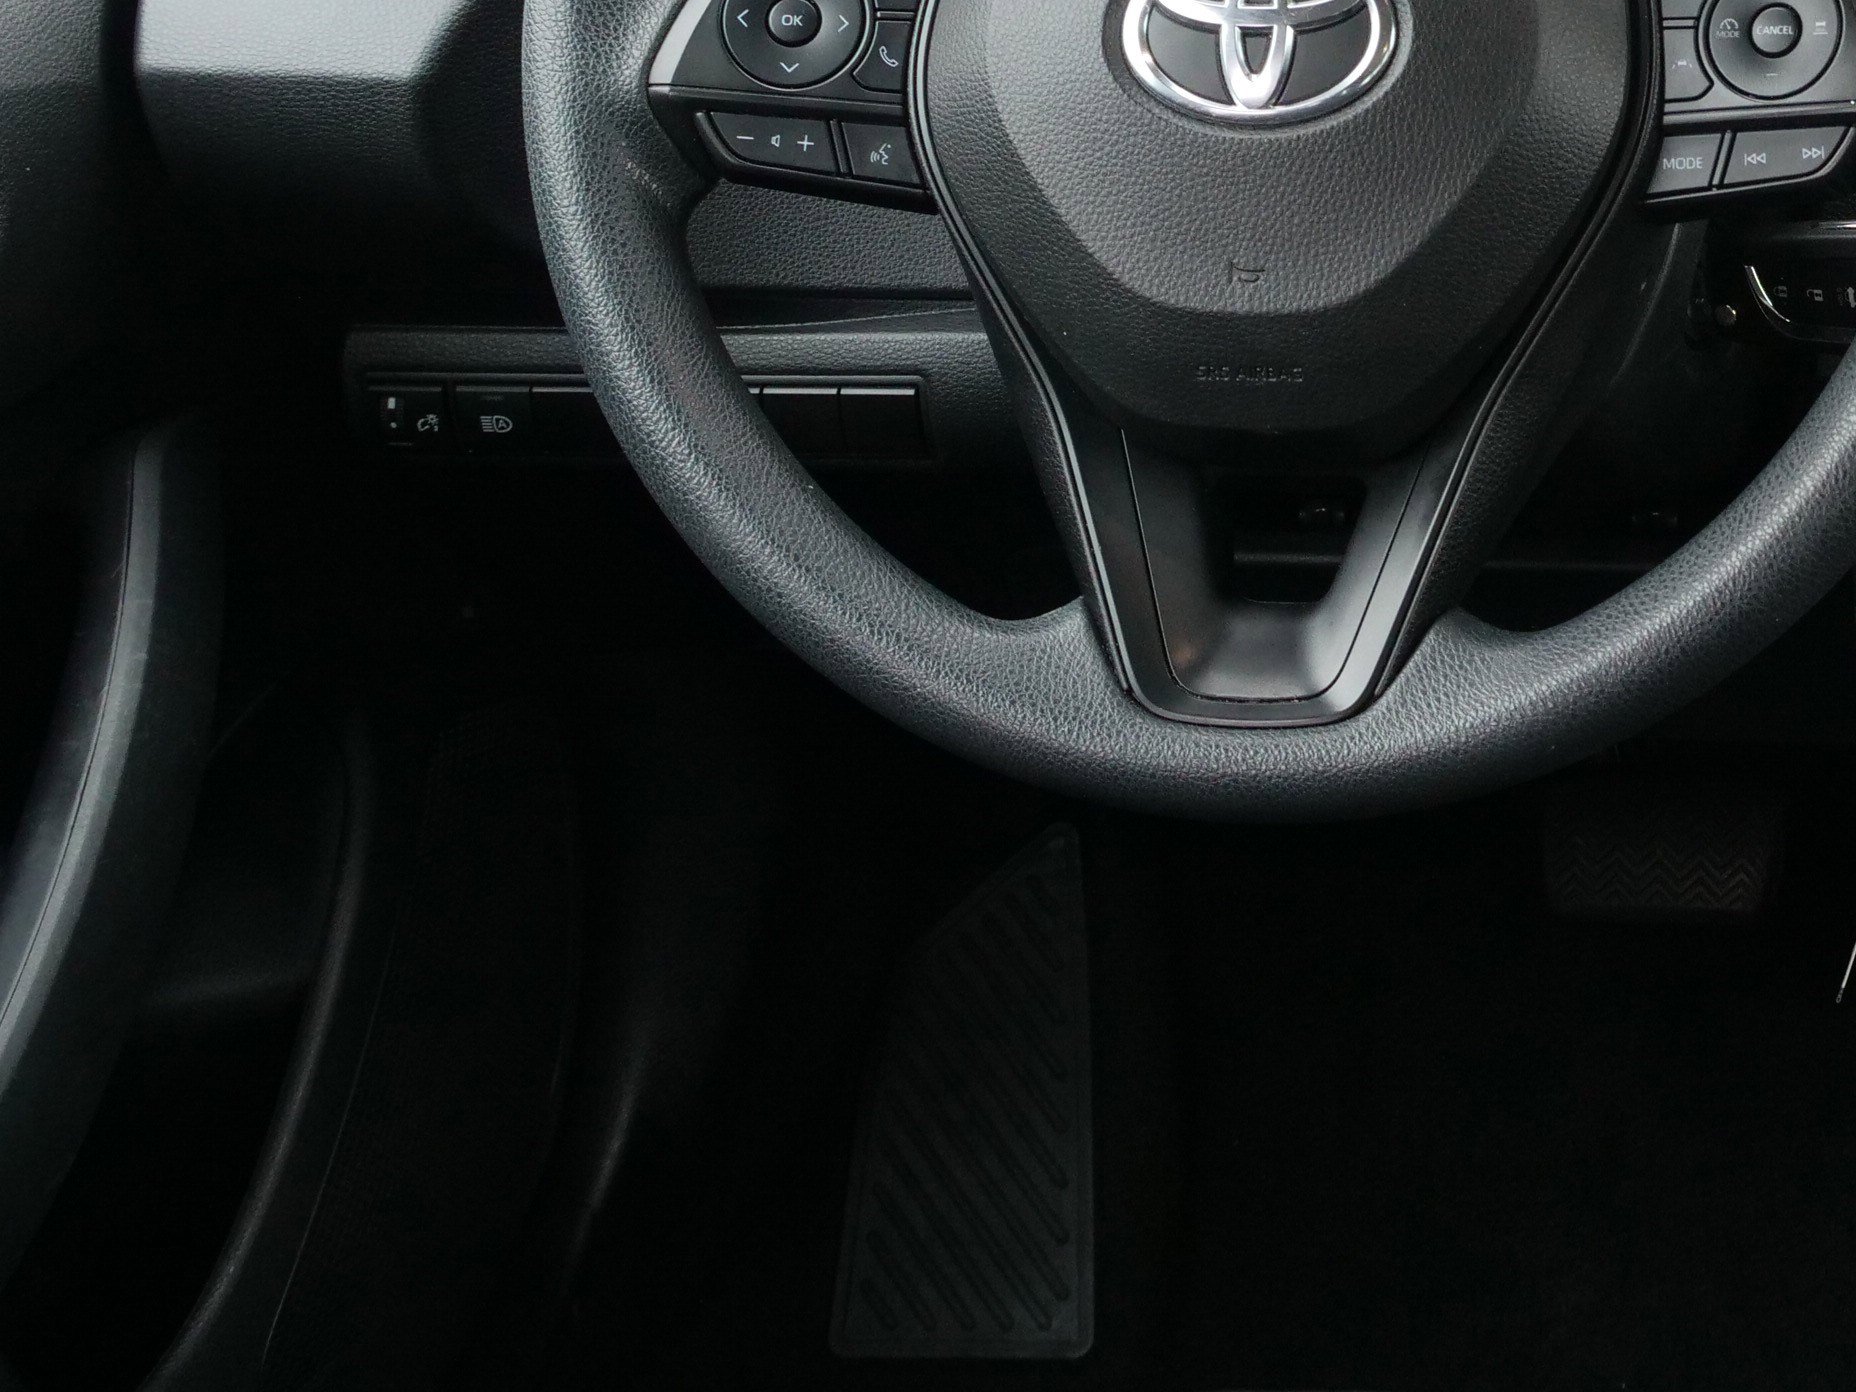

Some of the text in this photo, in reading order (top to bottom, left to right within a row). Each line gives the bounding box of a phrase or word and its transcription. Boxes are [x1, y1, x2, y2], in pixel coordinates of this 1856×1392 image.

[781, 14, 804, 26] OK
[1715, 30, 1740, 38] MODE
[1756, 25, 1794, 35] CANCEL
[1662, 157, 1703, 170] MODE
